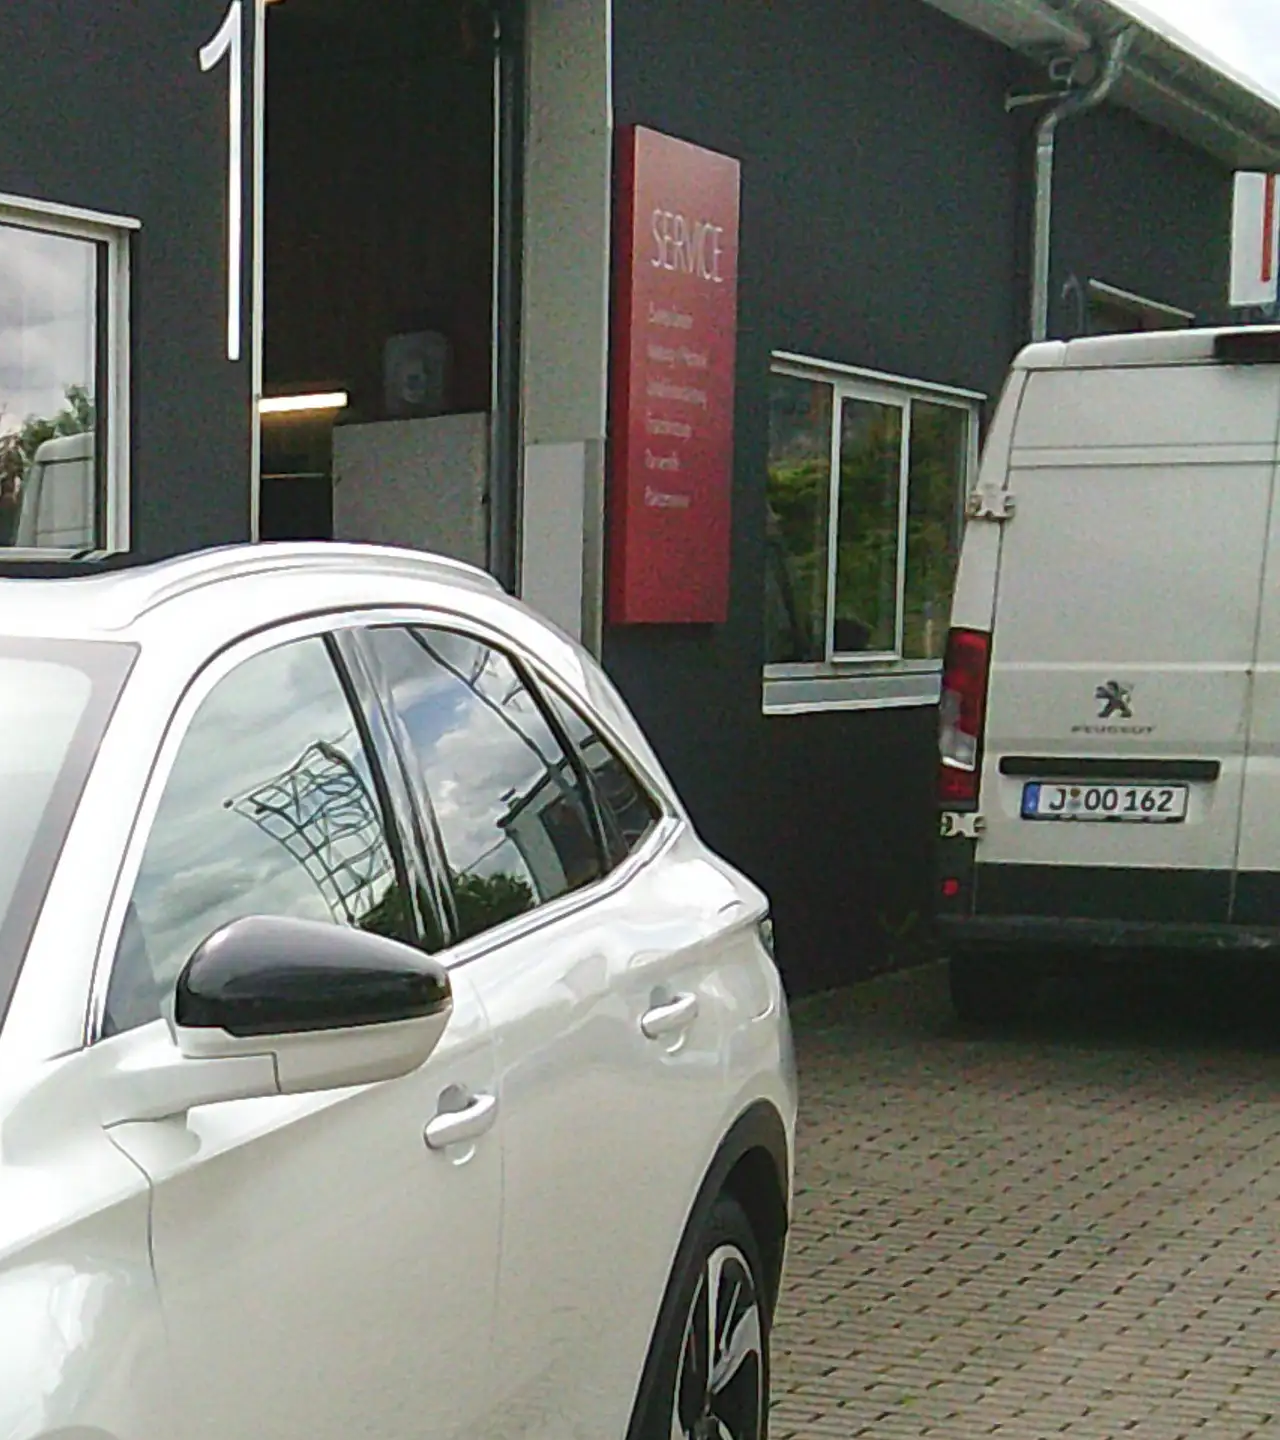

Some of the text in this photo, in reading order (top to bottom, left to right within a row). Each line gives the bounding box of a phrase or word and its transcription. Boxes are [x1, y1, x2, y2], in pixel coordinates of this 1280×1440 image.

[198, 0, 243, 361] 1
[650, 207, 724, 284] SERVICE
[1070, 724, 1156, 734] PEUGEOT
[1123, 790, 1174, 813] 162
